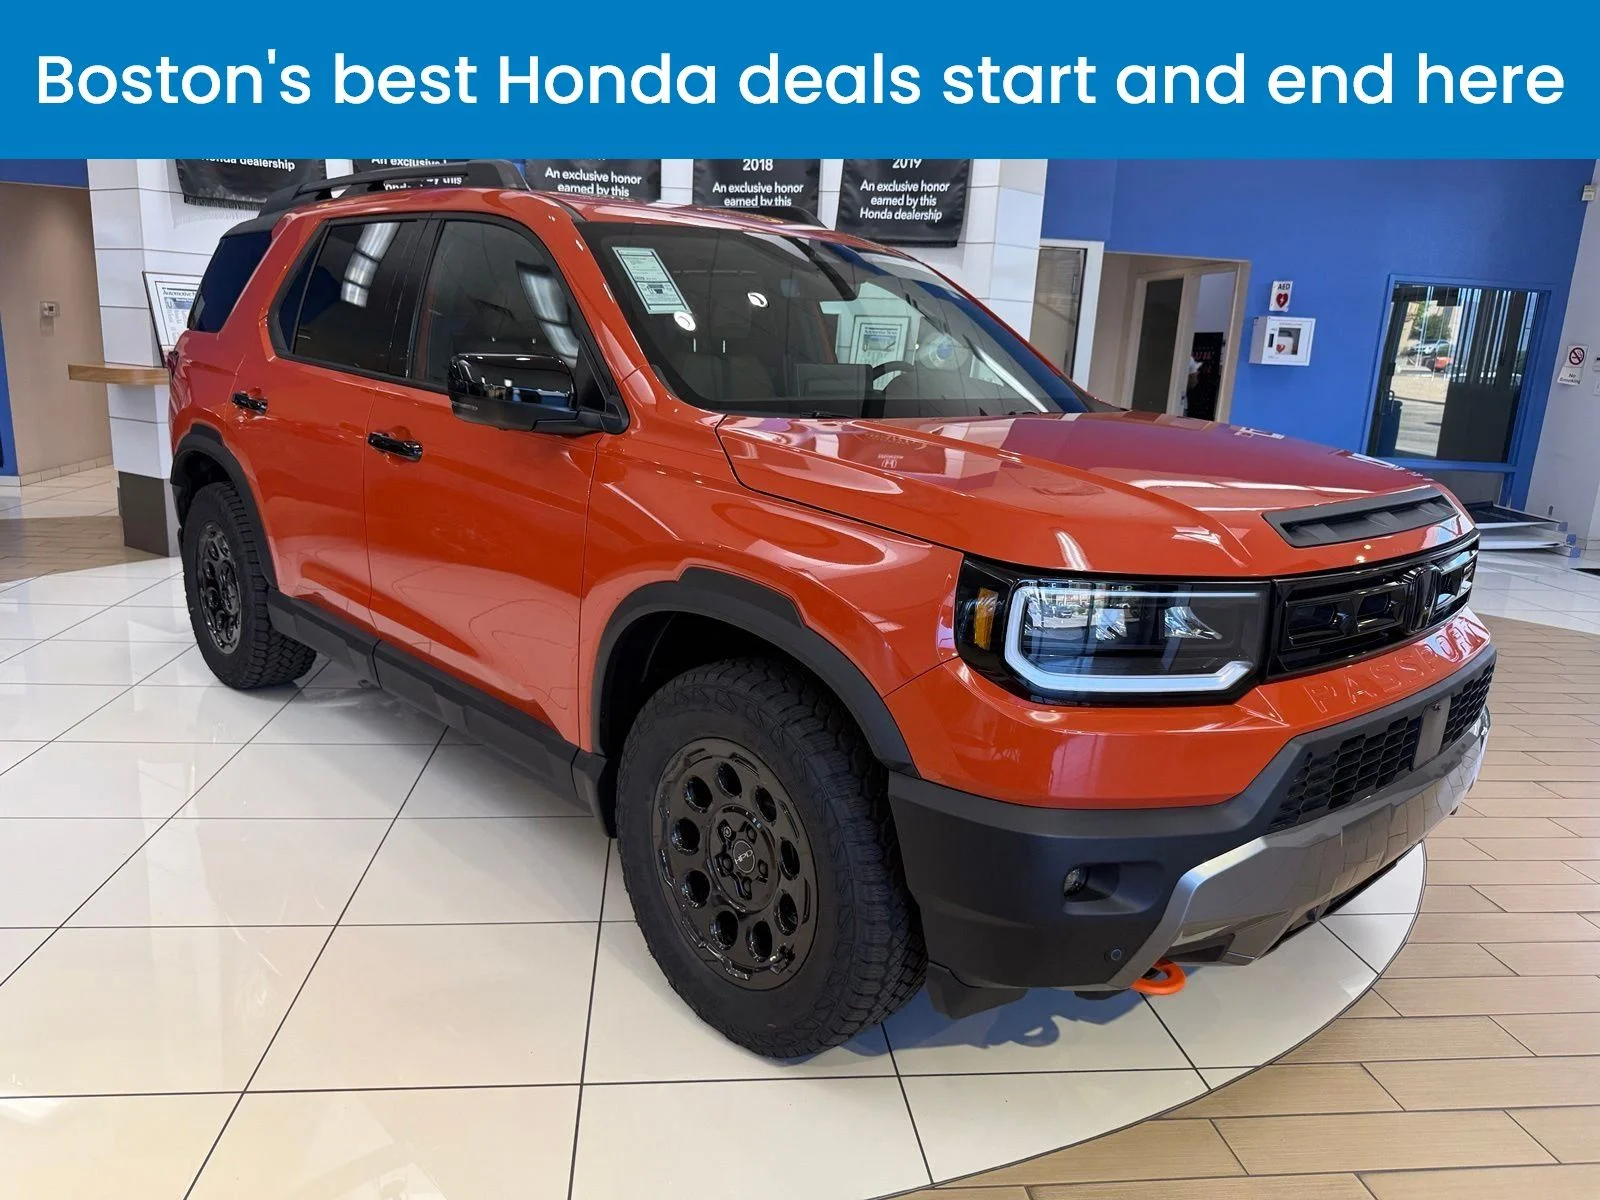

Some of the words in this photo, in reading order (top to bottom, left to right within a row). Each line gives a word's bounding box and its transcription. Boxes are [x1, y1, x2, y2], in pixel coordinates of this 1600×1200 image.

[742, 158, 774, 171] 2018
[892, 158, 922, 169] 2019
[544, 166, 560, 179] An
[562, 168, 609, 183] exclusive
[611, 171, 642, 185] honor
[557, 183, 594, 195] earned
[596, 184, 609, 195] by
[611, 185, 630, 197] this
[712, 181, 727, 193] An
[728, 181, 773, 194] exclusive
[774, 181, 804, 193] honor
[860, 179, 875, 192] An
[876, 179, 919, 192] exclusive
[920, 179, 950, 192] honor
[723, 195, 758, 207] earned
[760, 195, 773, 206] by
[774, 195, 792, 207] this
[870, 194, 905, 206] earned
[906, 194, 919, 209] by
[919, 194, 937, 206] this
[860, 207, 893, 220] Honda
[894, 208, 943, 223] dealership
[1277, 283, 1291, 291] AED
